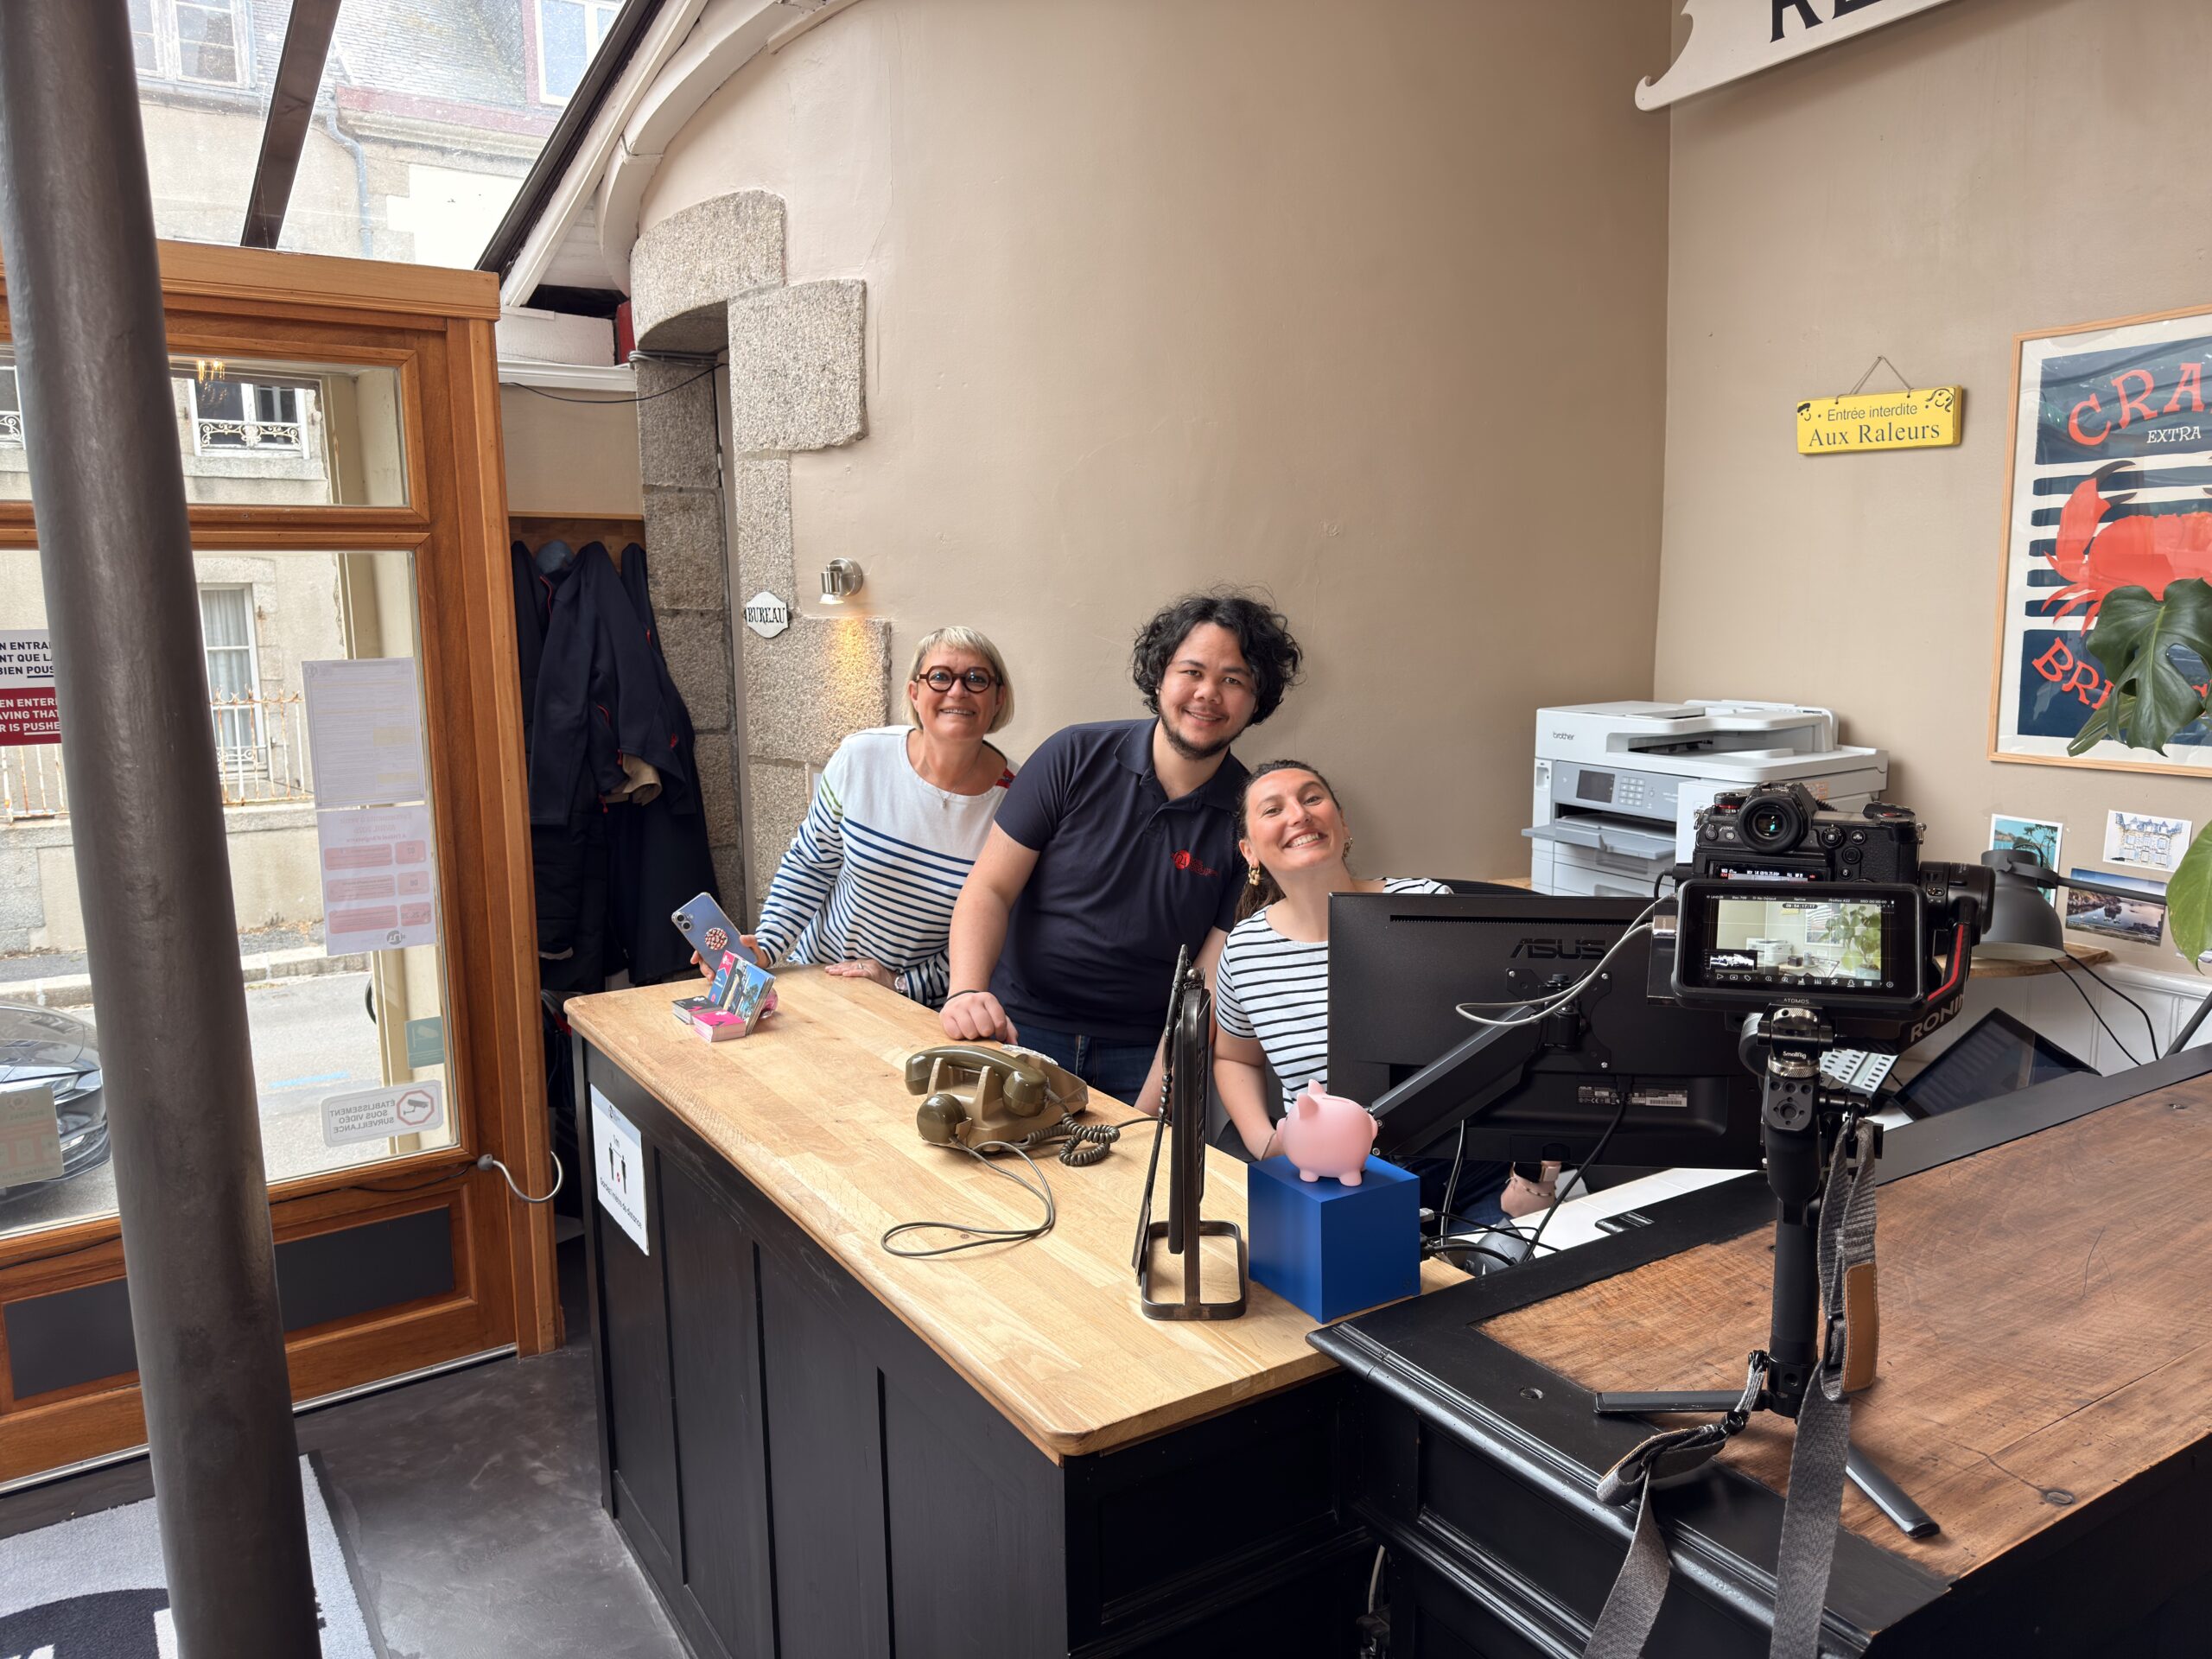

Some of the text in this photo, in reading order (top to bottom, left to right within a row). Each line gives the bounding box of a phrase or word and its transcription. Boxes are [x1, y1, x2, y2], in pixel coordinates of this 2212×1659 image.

[1827, 403, 1918, 422] Entrée interdite
[2068, 362, 2212, 447] CRA
[1808, 423, 1940, 447] Aux Raleurs
[2146, 425, 2202, 444] EXTRA
[747, 607, 785, 625] BUREAU
[10, 641, 52, 651] ENTRA
[43, 653, 52, 662] L
[9, 723, 21, 732] IS
[1553, 731, 1574, 741] brother
[1510, 938, 1605, 959] ASUS
[1783, 1051, 1807, 1059] SmallRig
